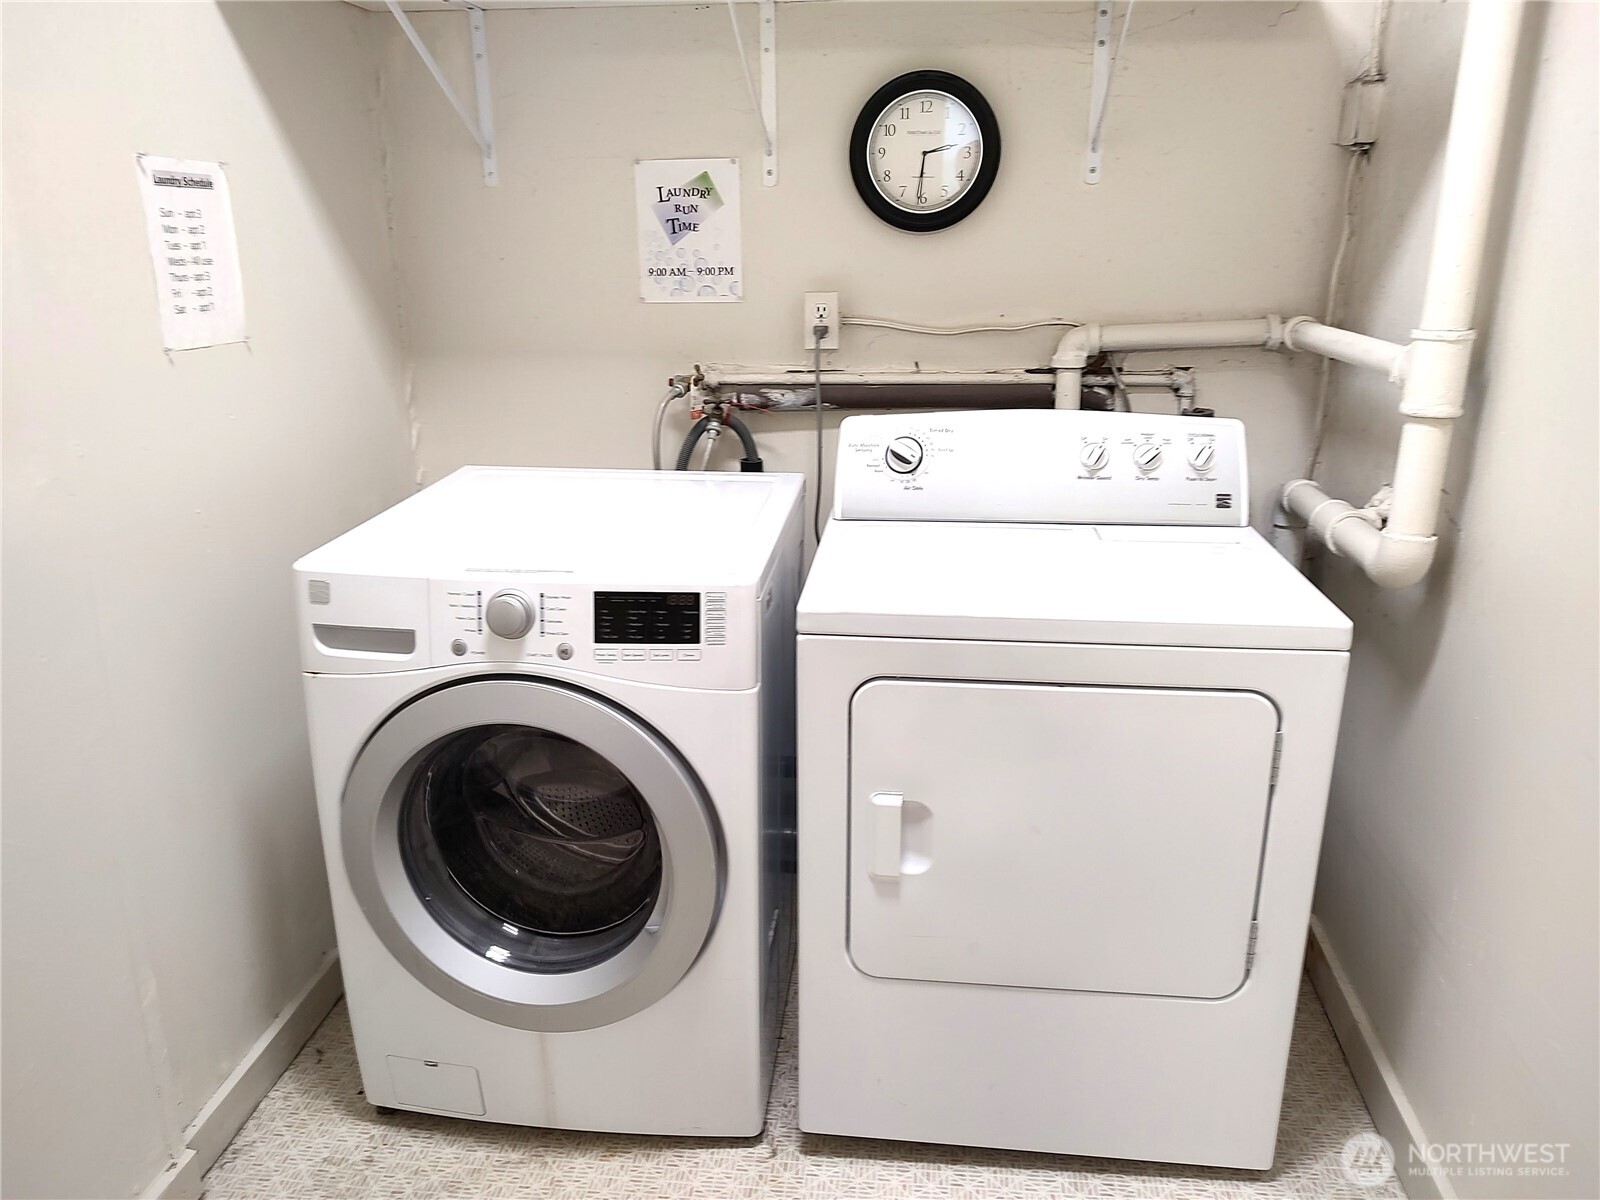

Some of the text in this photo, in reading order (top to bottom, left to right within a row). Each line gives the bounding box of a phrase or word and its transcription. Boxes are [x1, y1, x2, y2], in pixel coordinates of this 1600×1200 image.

[919, 100, 933, 113] 12
[899, 107, 910, 119] 11
[883, 124, 896, 136] 10
[957, 123, 966, 135] 2
[878, 147, 886, 158] 9
[962, 146, 971, 158] 3
[152, 174, 213, 188] Laundry Schedule
[883, 170, 891, 182] 8
[955, 169, 965, 181] 4
[899, 186, 907, 197] 7
[940, 185, 948, 197] 5
[919, 192, 928, 204] 6
[674, 204, 699, 215] RUN
[648, 267, 667, 276] 9:00
[668, 267, 687, 276] AM
[696, 267, 716, 276] 9:00
[718, 266, 735, 276] PM
